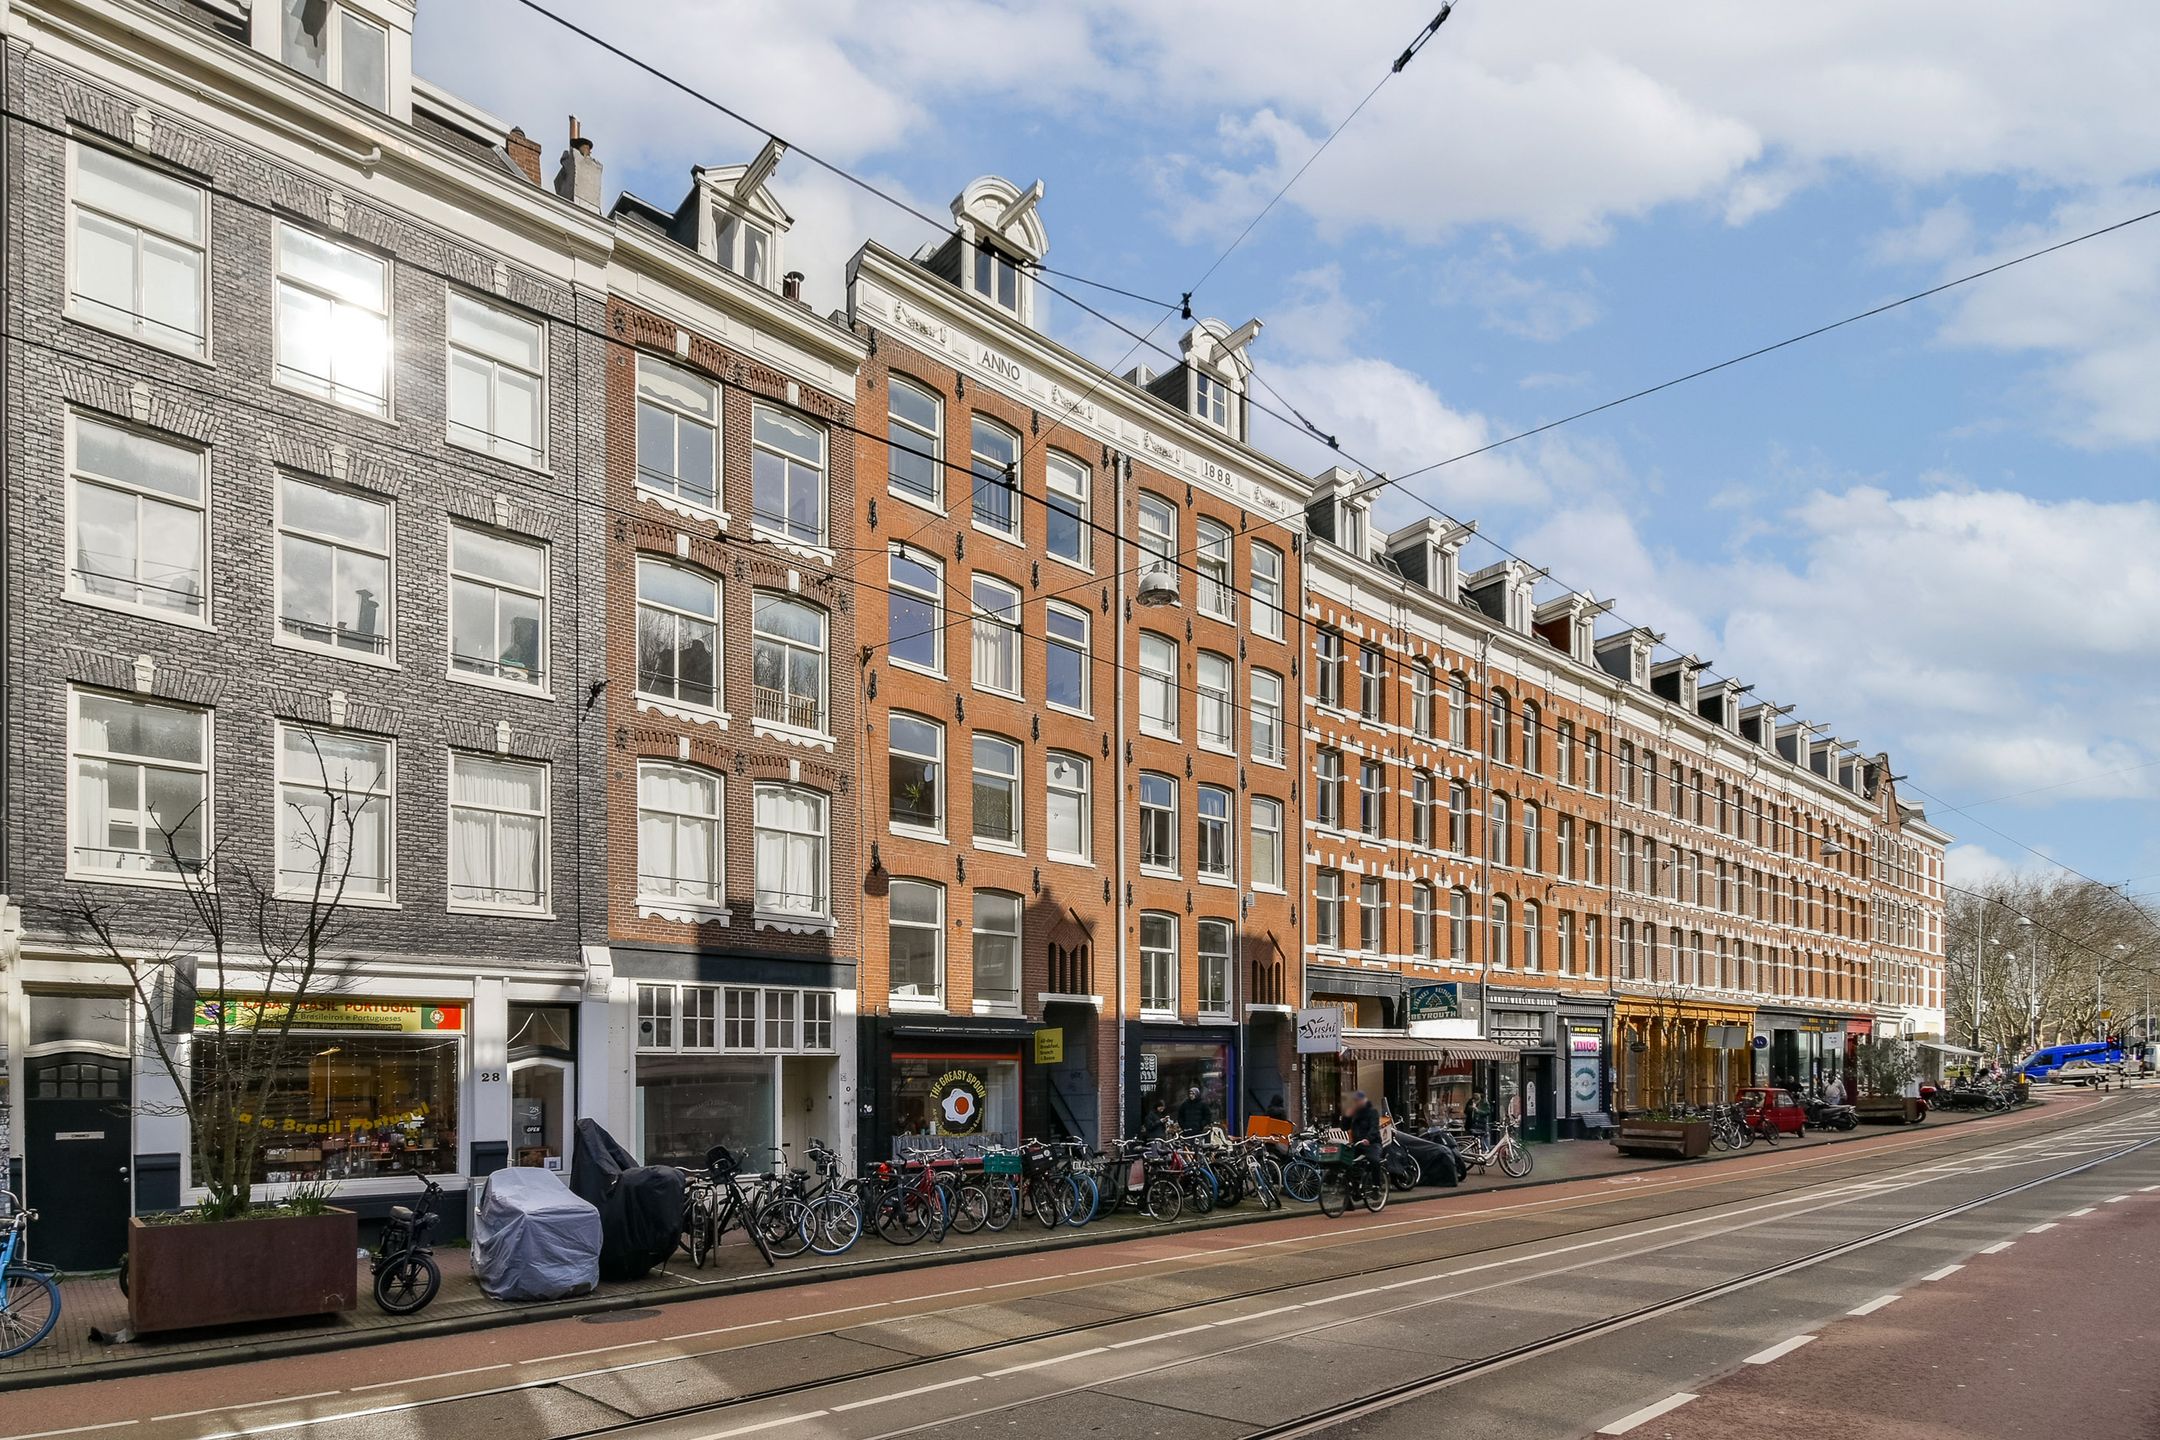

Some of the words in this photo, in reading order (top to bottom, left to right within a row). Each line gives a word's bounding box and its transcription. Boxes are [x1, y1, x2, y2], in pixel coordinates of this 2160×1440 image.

[982, 350, 1020, 380] ANNO
[294, 999, 338, 1012] RASIL
[344, 1001, 416, 1013] PORTUGAL
[353, 1015, 401, 1023] Portugueses
[1411, 1010, 1456, 1020] BEYROUTH
[481, 1072, 500, 1082] 28
[929, 1082, 942, 1099] THE
[939, 1070, 967, 1087] GREASY
[966, 1073, 986, 1098] SPOON
[282, 1118, 341, 1134] Brasil
[349, 1102, 431, 1133] Portugal
